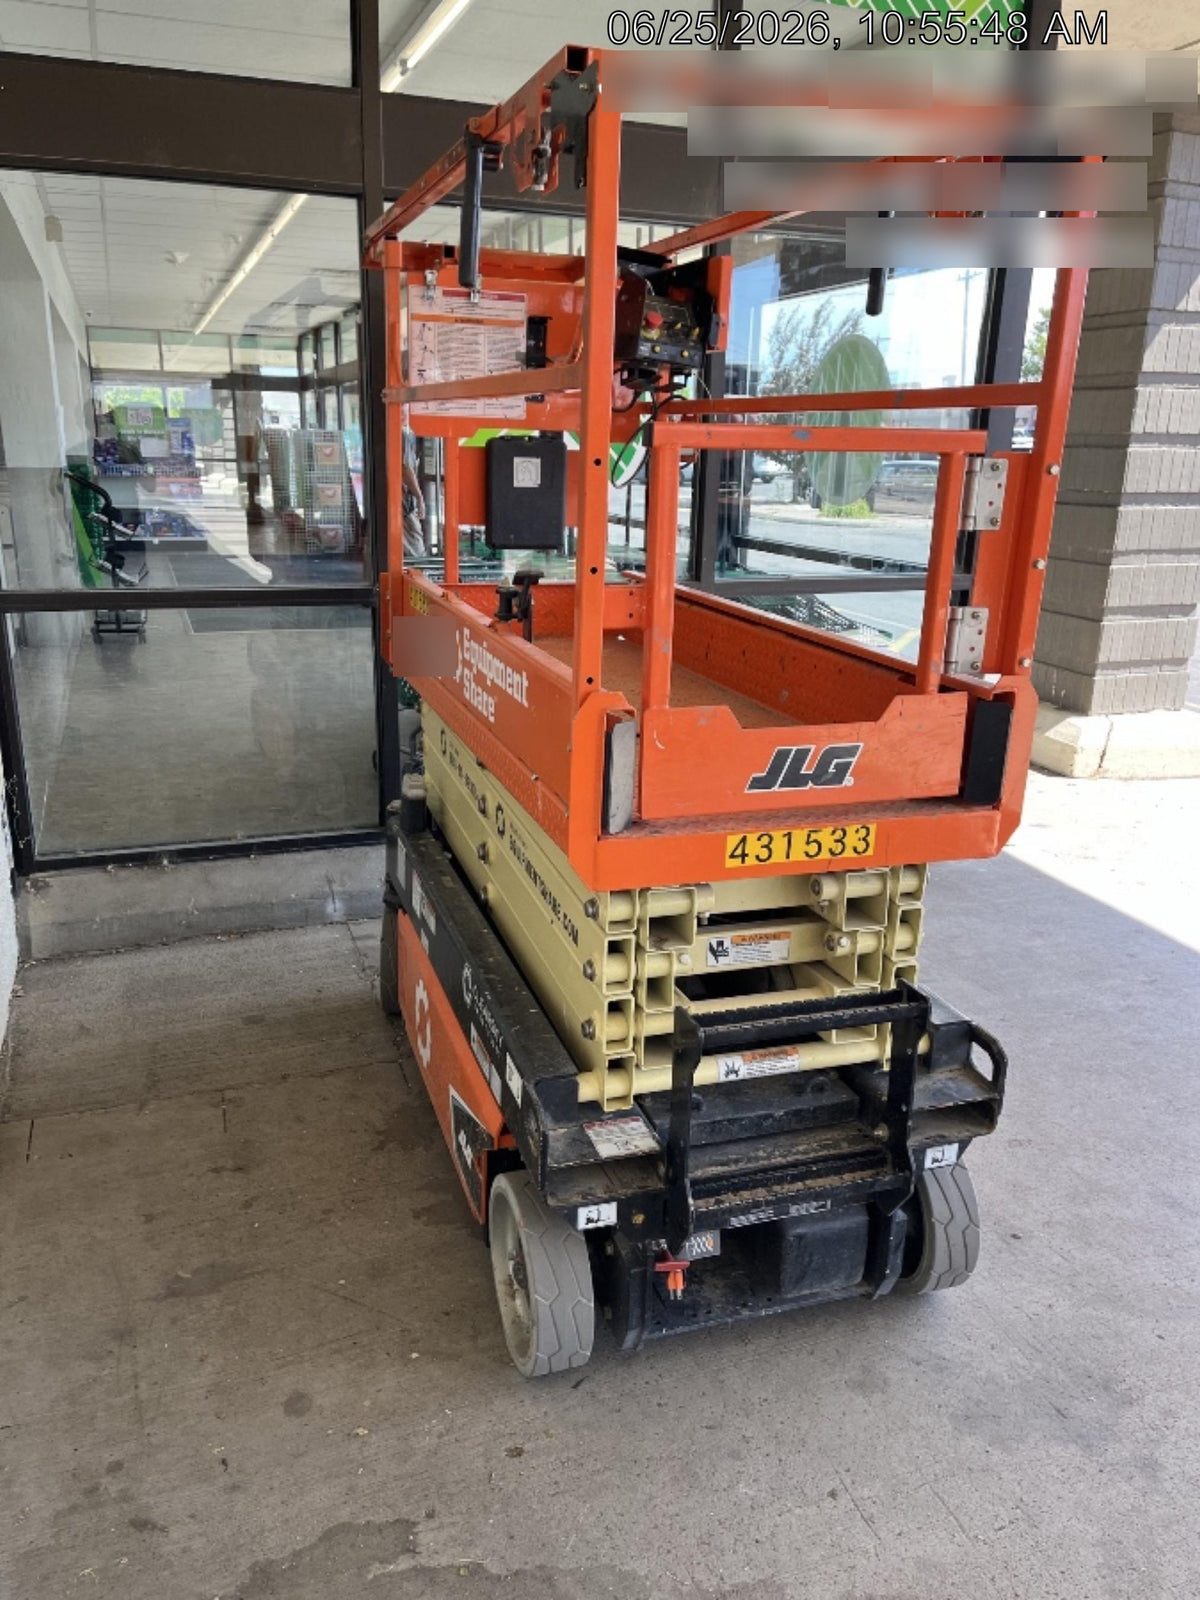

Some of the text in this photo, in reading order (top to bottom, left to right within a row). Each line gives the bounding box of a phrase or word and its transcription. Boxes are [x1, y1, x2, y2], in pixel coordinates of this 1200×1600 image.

[463, 627, 529, 708] Equipment
[463, 667, 495, 724] Share
[744, 742, 864, 793] JLG
[728, 824, 871, 865] 431533
